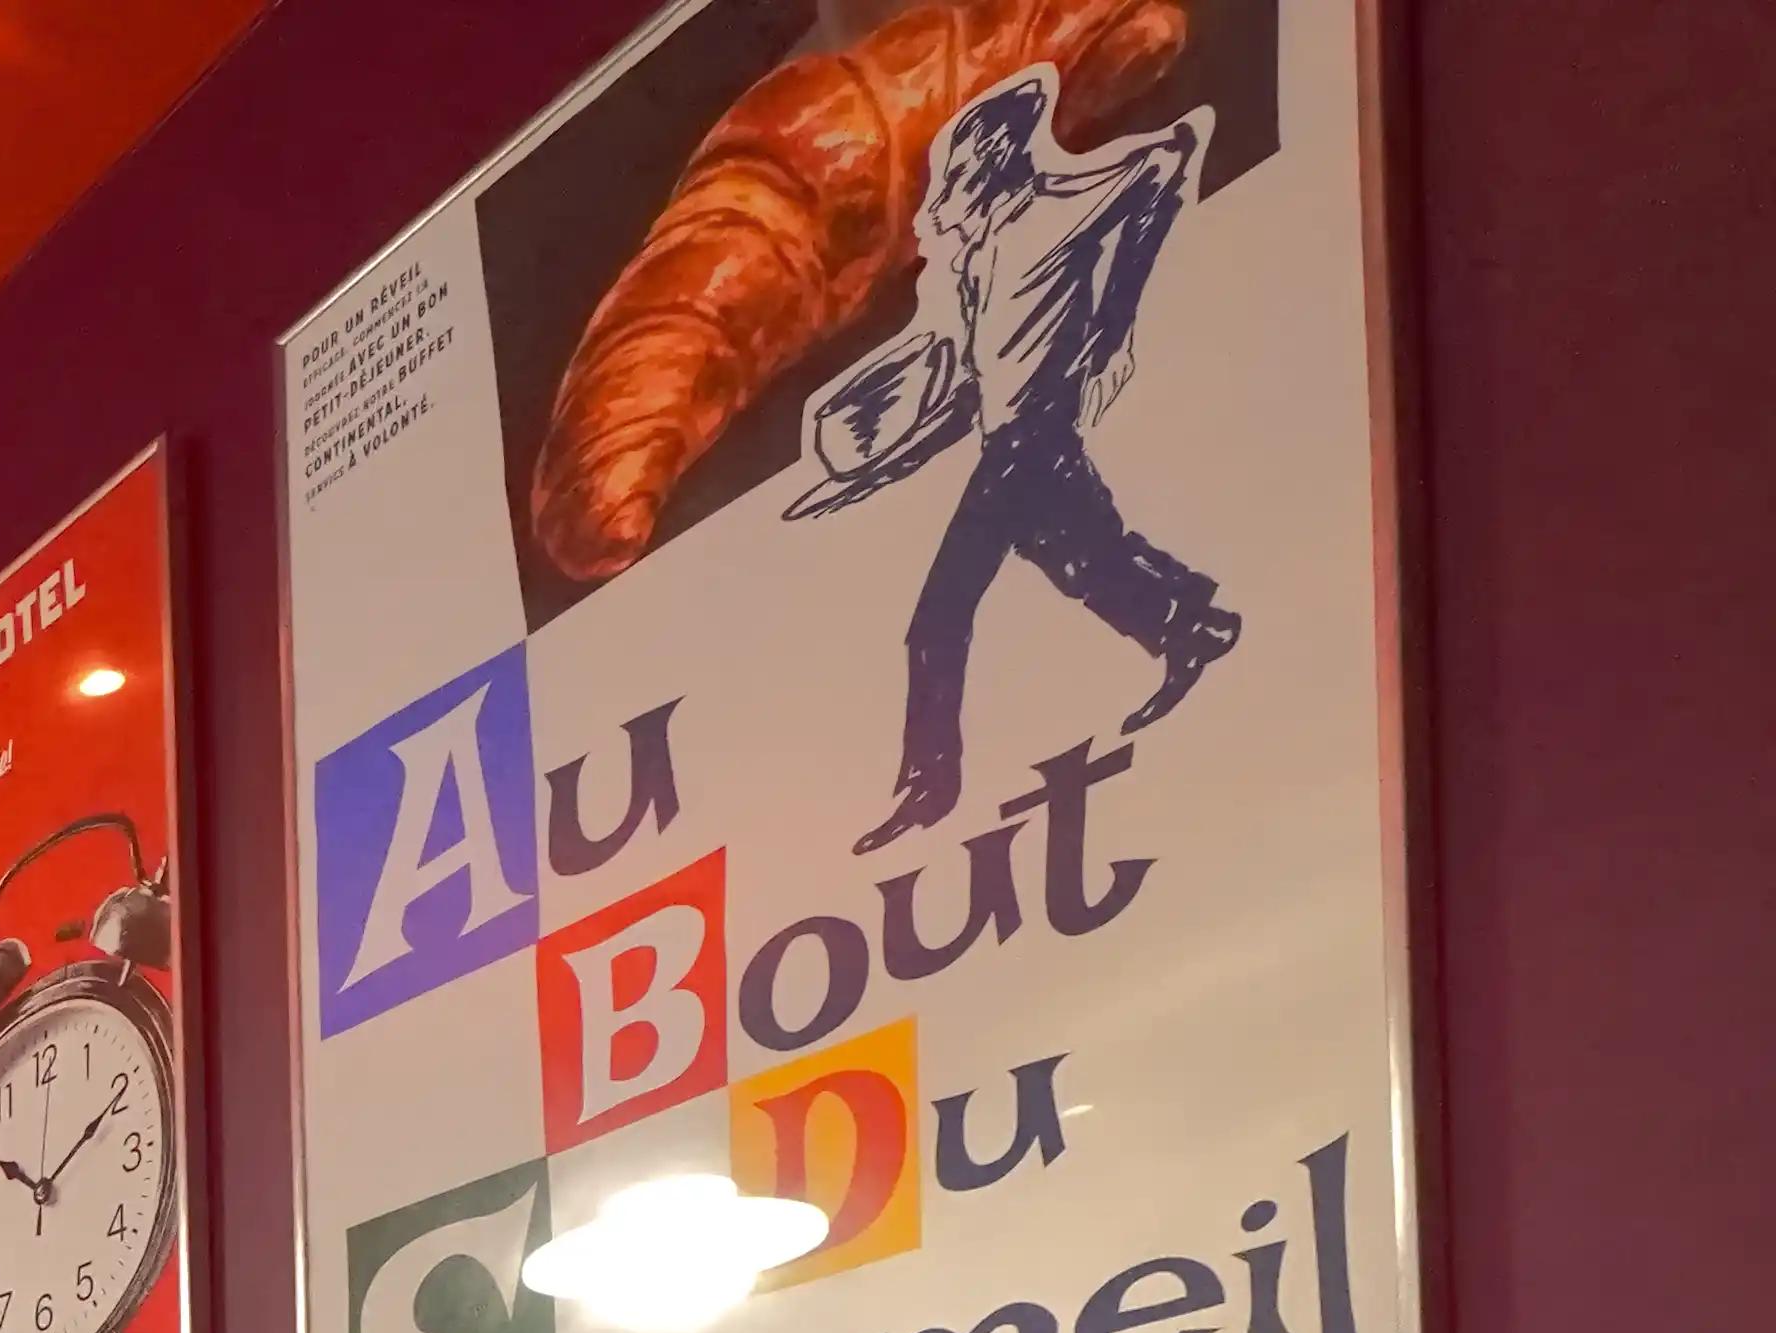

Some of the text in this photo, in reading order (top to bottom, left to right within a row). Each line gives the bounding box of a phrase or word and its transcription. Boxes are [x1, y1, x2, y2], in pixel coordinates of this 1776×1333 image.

[302, 262, 421, 368] POUR UN RÉVEIL
[348, 335, 385, 376] AVEC
[391, 314, 410, 339] UN
[417, 281, 448, 318] BON
[398, 326, 454, 384] BUFFET
[338, 681, 686, 994] Au
[561, 736, 1158, 1127] Bout
[32, 1043, 58, 1088] 12
[84, 1042, 90, 1081] 1
[110, 1072, 129, 1116] 2
[122, 1131, 142, 1173] 3
[754, 1052, 1071, 1250] Du
[107, 1203, 128, 1243] 4
[76, 1261, 94, 1301] 5
[35, 1293, 53, 1331] 6
